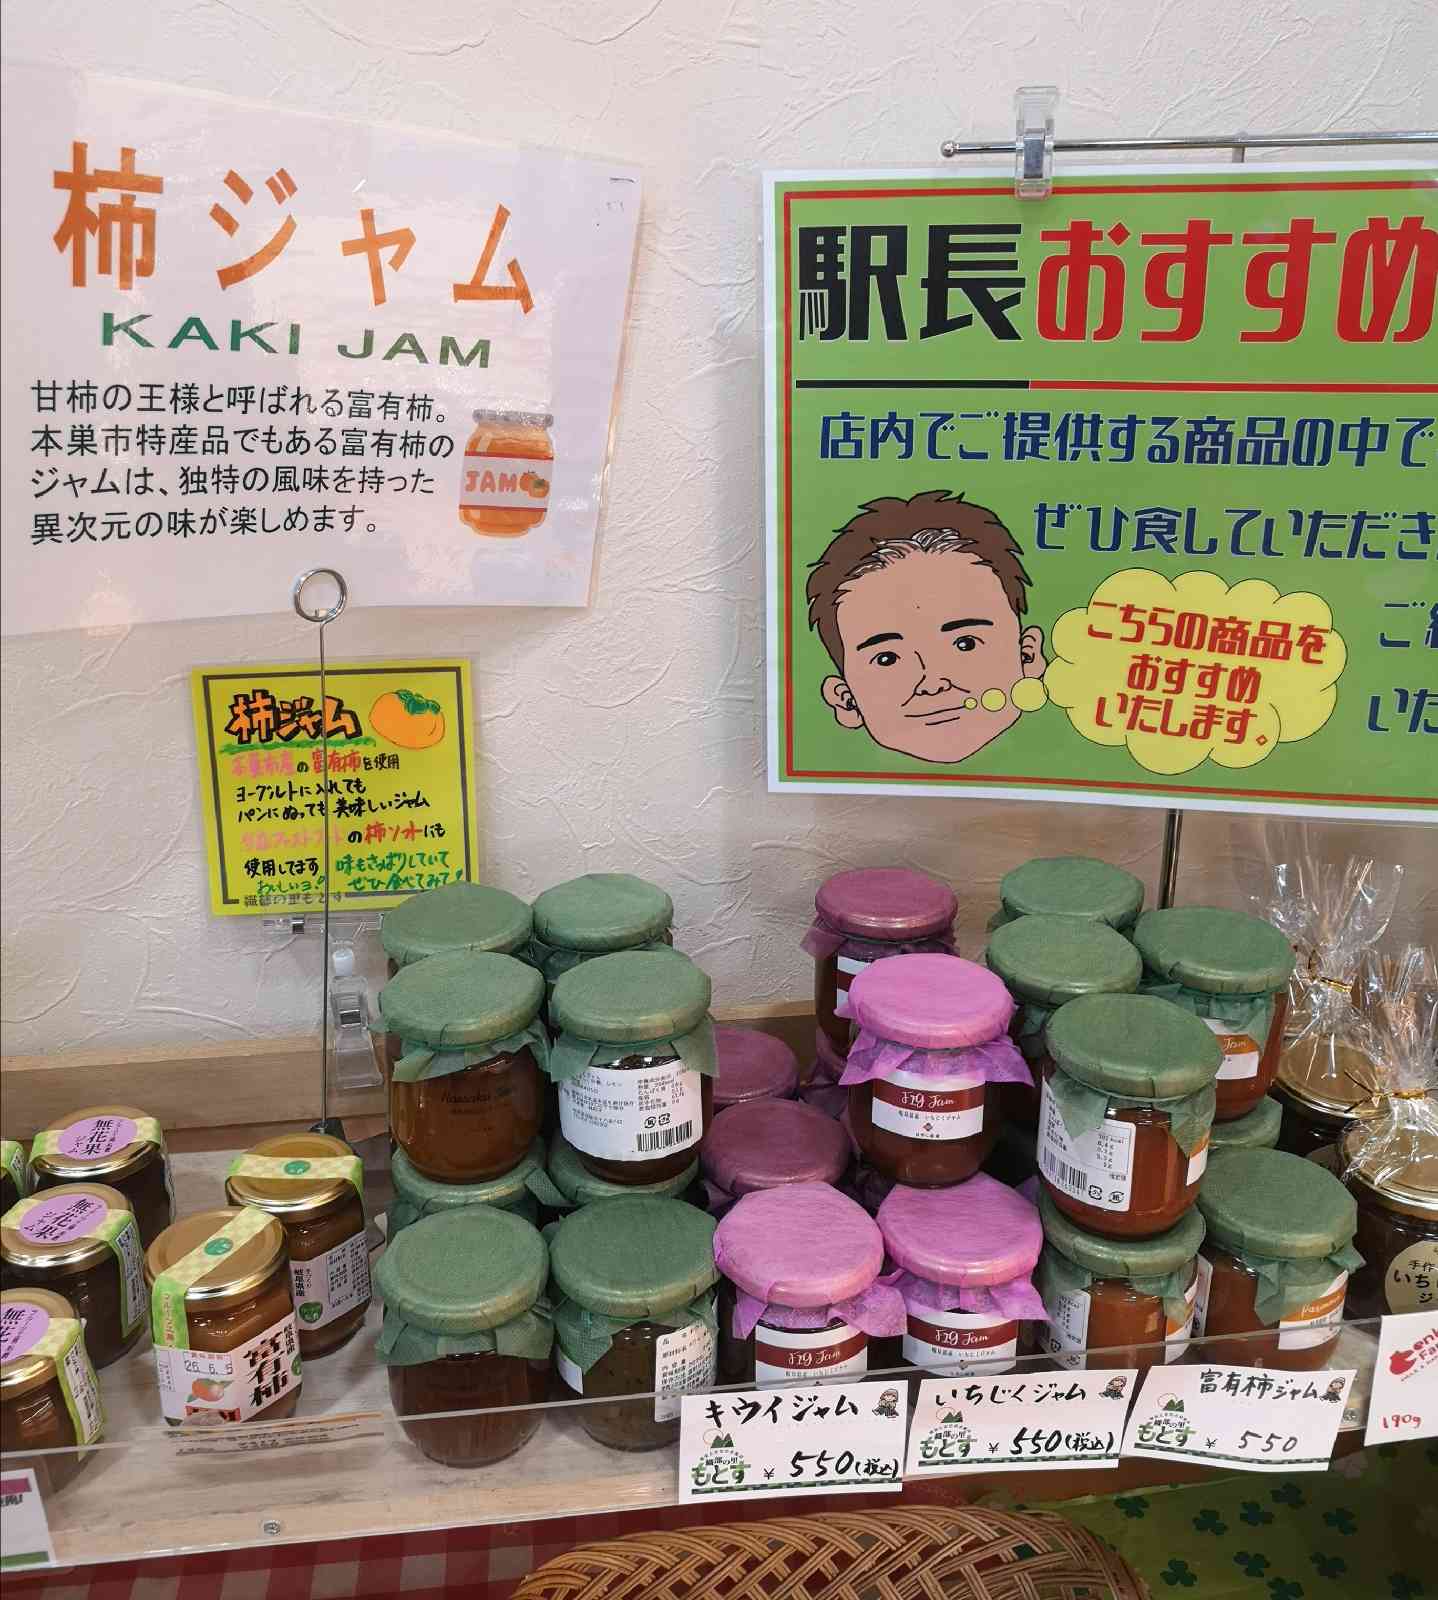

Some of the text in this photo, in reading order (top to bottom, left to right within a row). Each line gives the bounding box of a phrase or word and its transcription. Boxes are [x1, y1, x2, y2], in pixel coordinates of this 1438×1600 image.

[53, 140, 535, 313] 柿ジャム
[798, 215, 1438, 344] 駅長おすすめ
[101, 312, 491, 368] KAKI JAM
[32, 380, 447, 424] 甘柿の王様と呼ばれる富有柿。
[31, 425, 454, 460] 本巣市特産品でもある富有柿の
[819, 411, 1437, 468] 店内でご提供する商品の中で
[32, 465, 436, 497] ジャムは、独特の風味を持った
[464, 470, 517, 494] JAM
[31, 505, 379, 545] 異次元の味が楽しめます。
[1087, 601, 1330, 665] こちらの商品を
[1126, 653, 1262, 705] おすすめ
[224, 690, 362, 744] 柿ジャム
[1095, 692, 1269, 746] いたします。
[236, 778, 367, 803] ヨーグルトに入れても
[901, 1091, 955, 1108] Fig Jam
[81, 1120, 113, 1155] 無花果
[32, 1199, 94, 1239] 無花果
[1394, 1270, 1438, 1289] いち
[935, 1329, 990, 1346] Fig Jam
[788, 1350, 841, 1367] Fig Jam
[936, 1382, 1087, 1406] いちじくジャム
[1199, 1368, 1318, 1400] 富有柿ジャム
[705, 1395, 859, 1428] キウイジャム
[920, 1438, 978, 1459] もとす
[1138, 1422, 1197, 1446] もとす
[1238, 1430, 1299, 1453] 550
[691, 1461, 752, 1486] もとす
